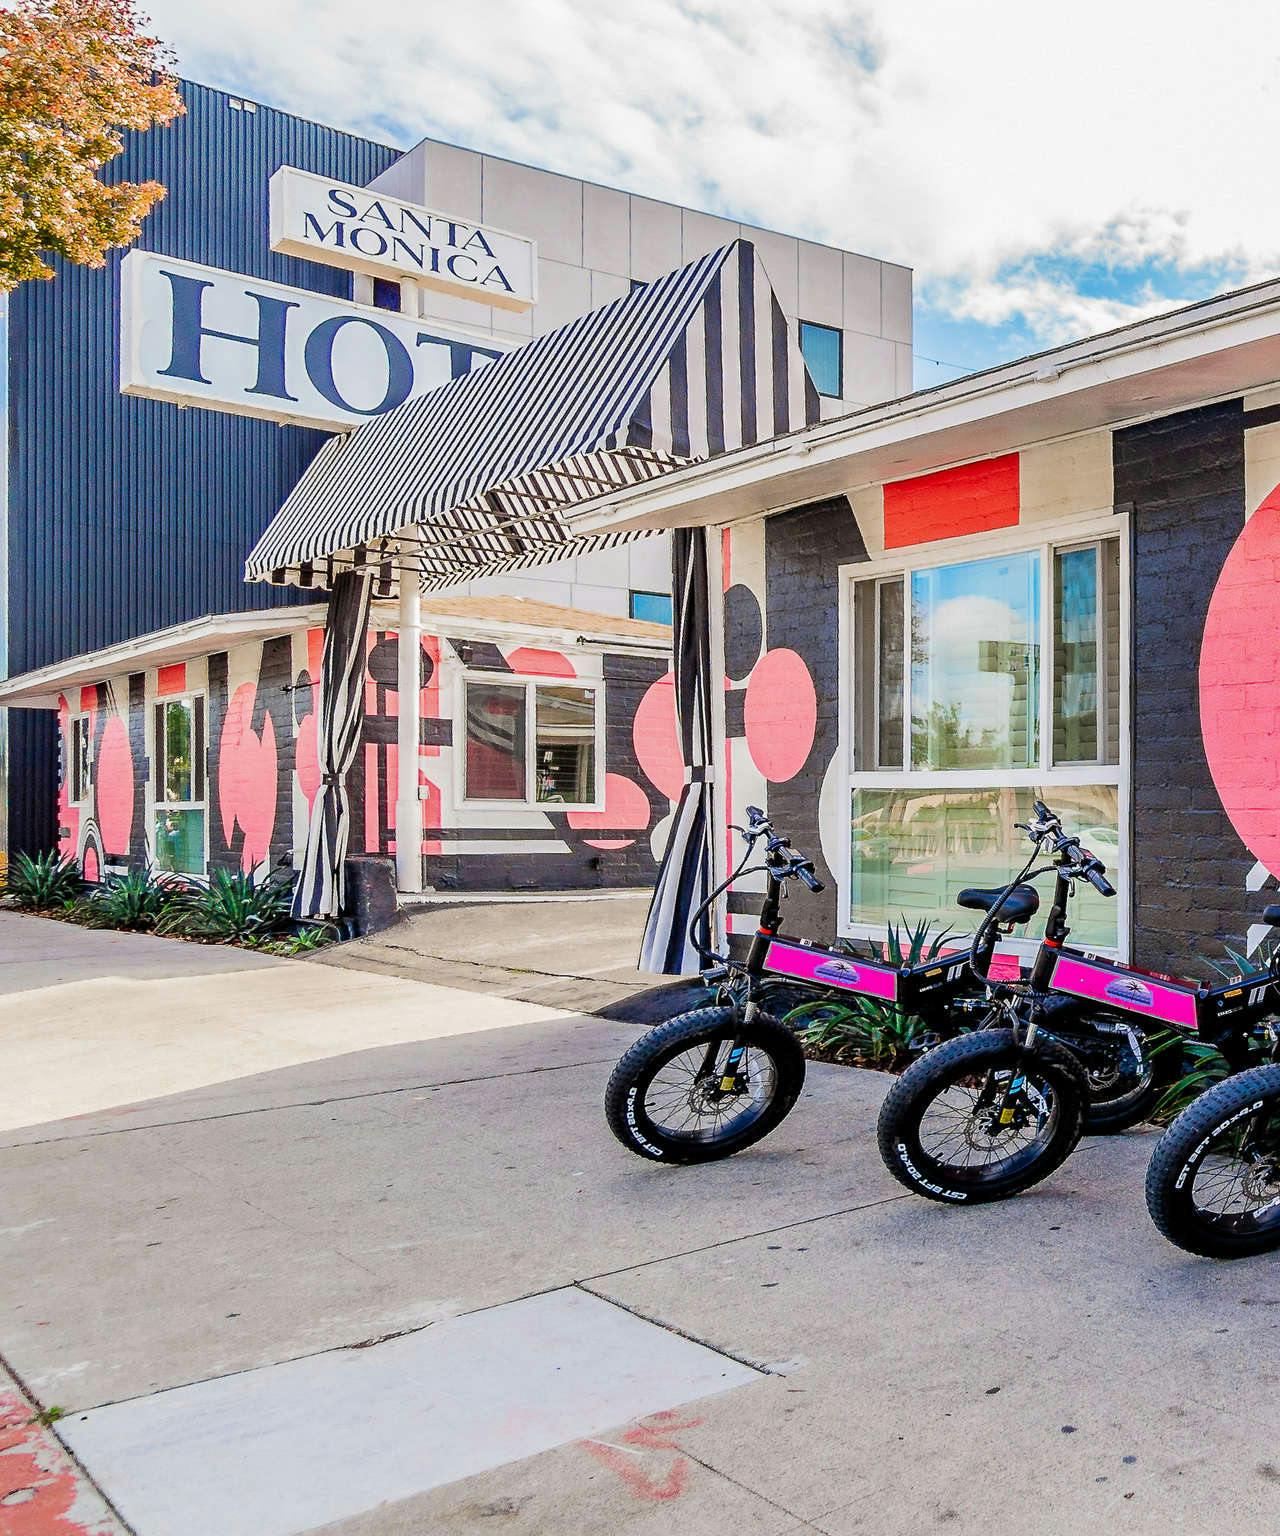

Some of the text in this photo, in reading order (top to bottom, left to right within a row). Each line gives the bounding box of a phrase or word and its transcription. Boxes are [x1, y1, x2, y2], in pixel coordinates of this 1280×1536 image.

[303, 211, 516, 294] MONICA
[327, 188, 497, 259] SANTA
[156, 270, 505, 417] HOT
[630, 1126, 647, 1144] BFT
[643, 1143, 663, 1156] CST
[1175, 1100, 1264, 1189] CST BFT 20x4.0
[897, 1143, 967, 1200] CST BFT 20x4.0
